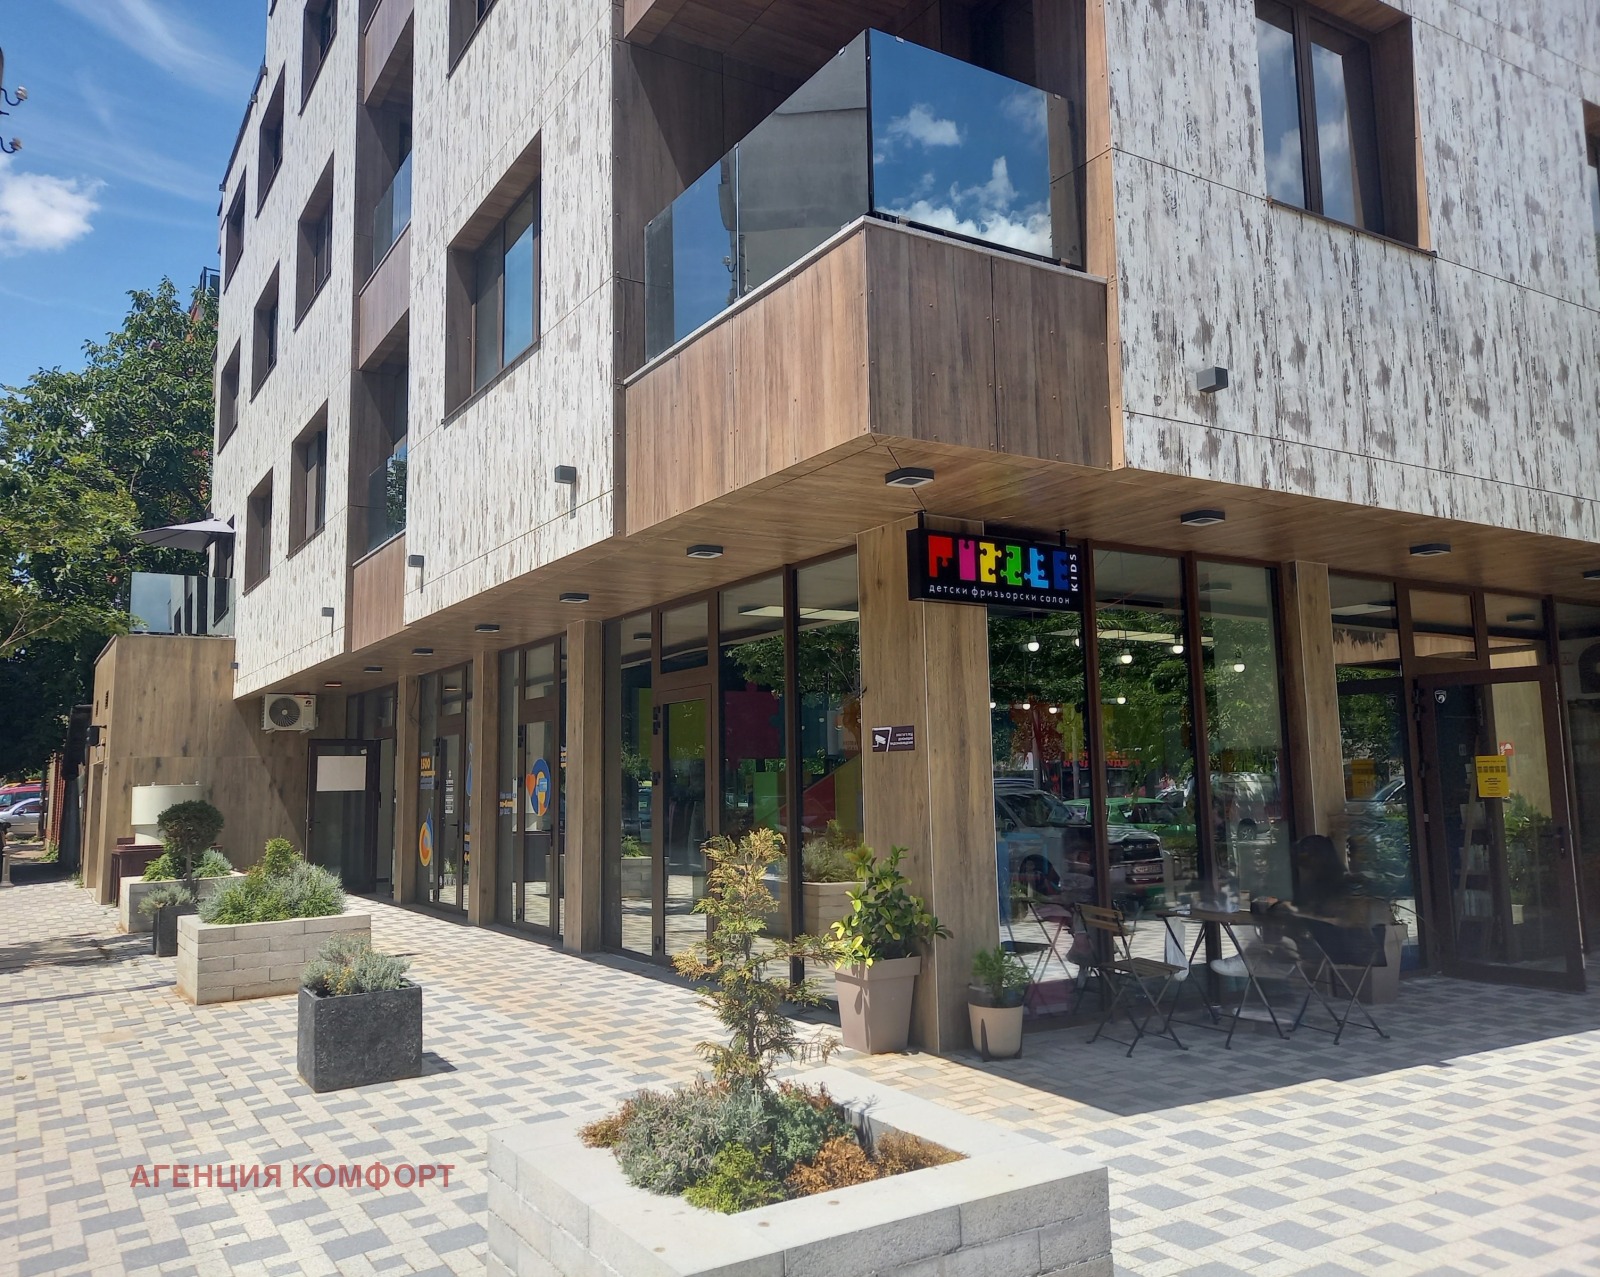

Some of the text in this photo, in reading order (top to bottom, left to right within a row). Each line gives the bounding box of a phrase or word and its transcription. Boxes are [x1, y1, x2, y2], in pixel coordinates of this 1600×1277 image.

[1069, 553, 1079, 592] KIDS
[929, 584, 1070, 605] детски фризьорски салон
